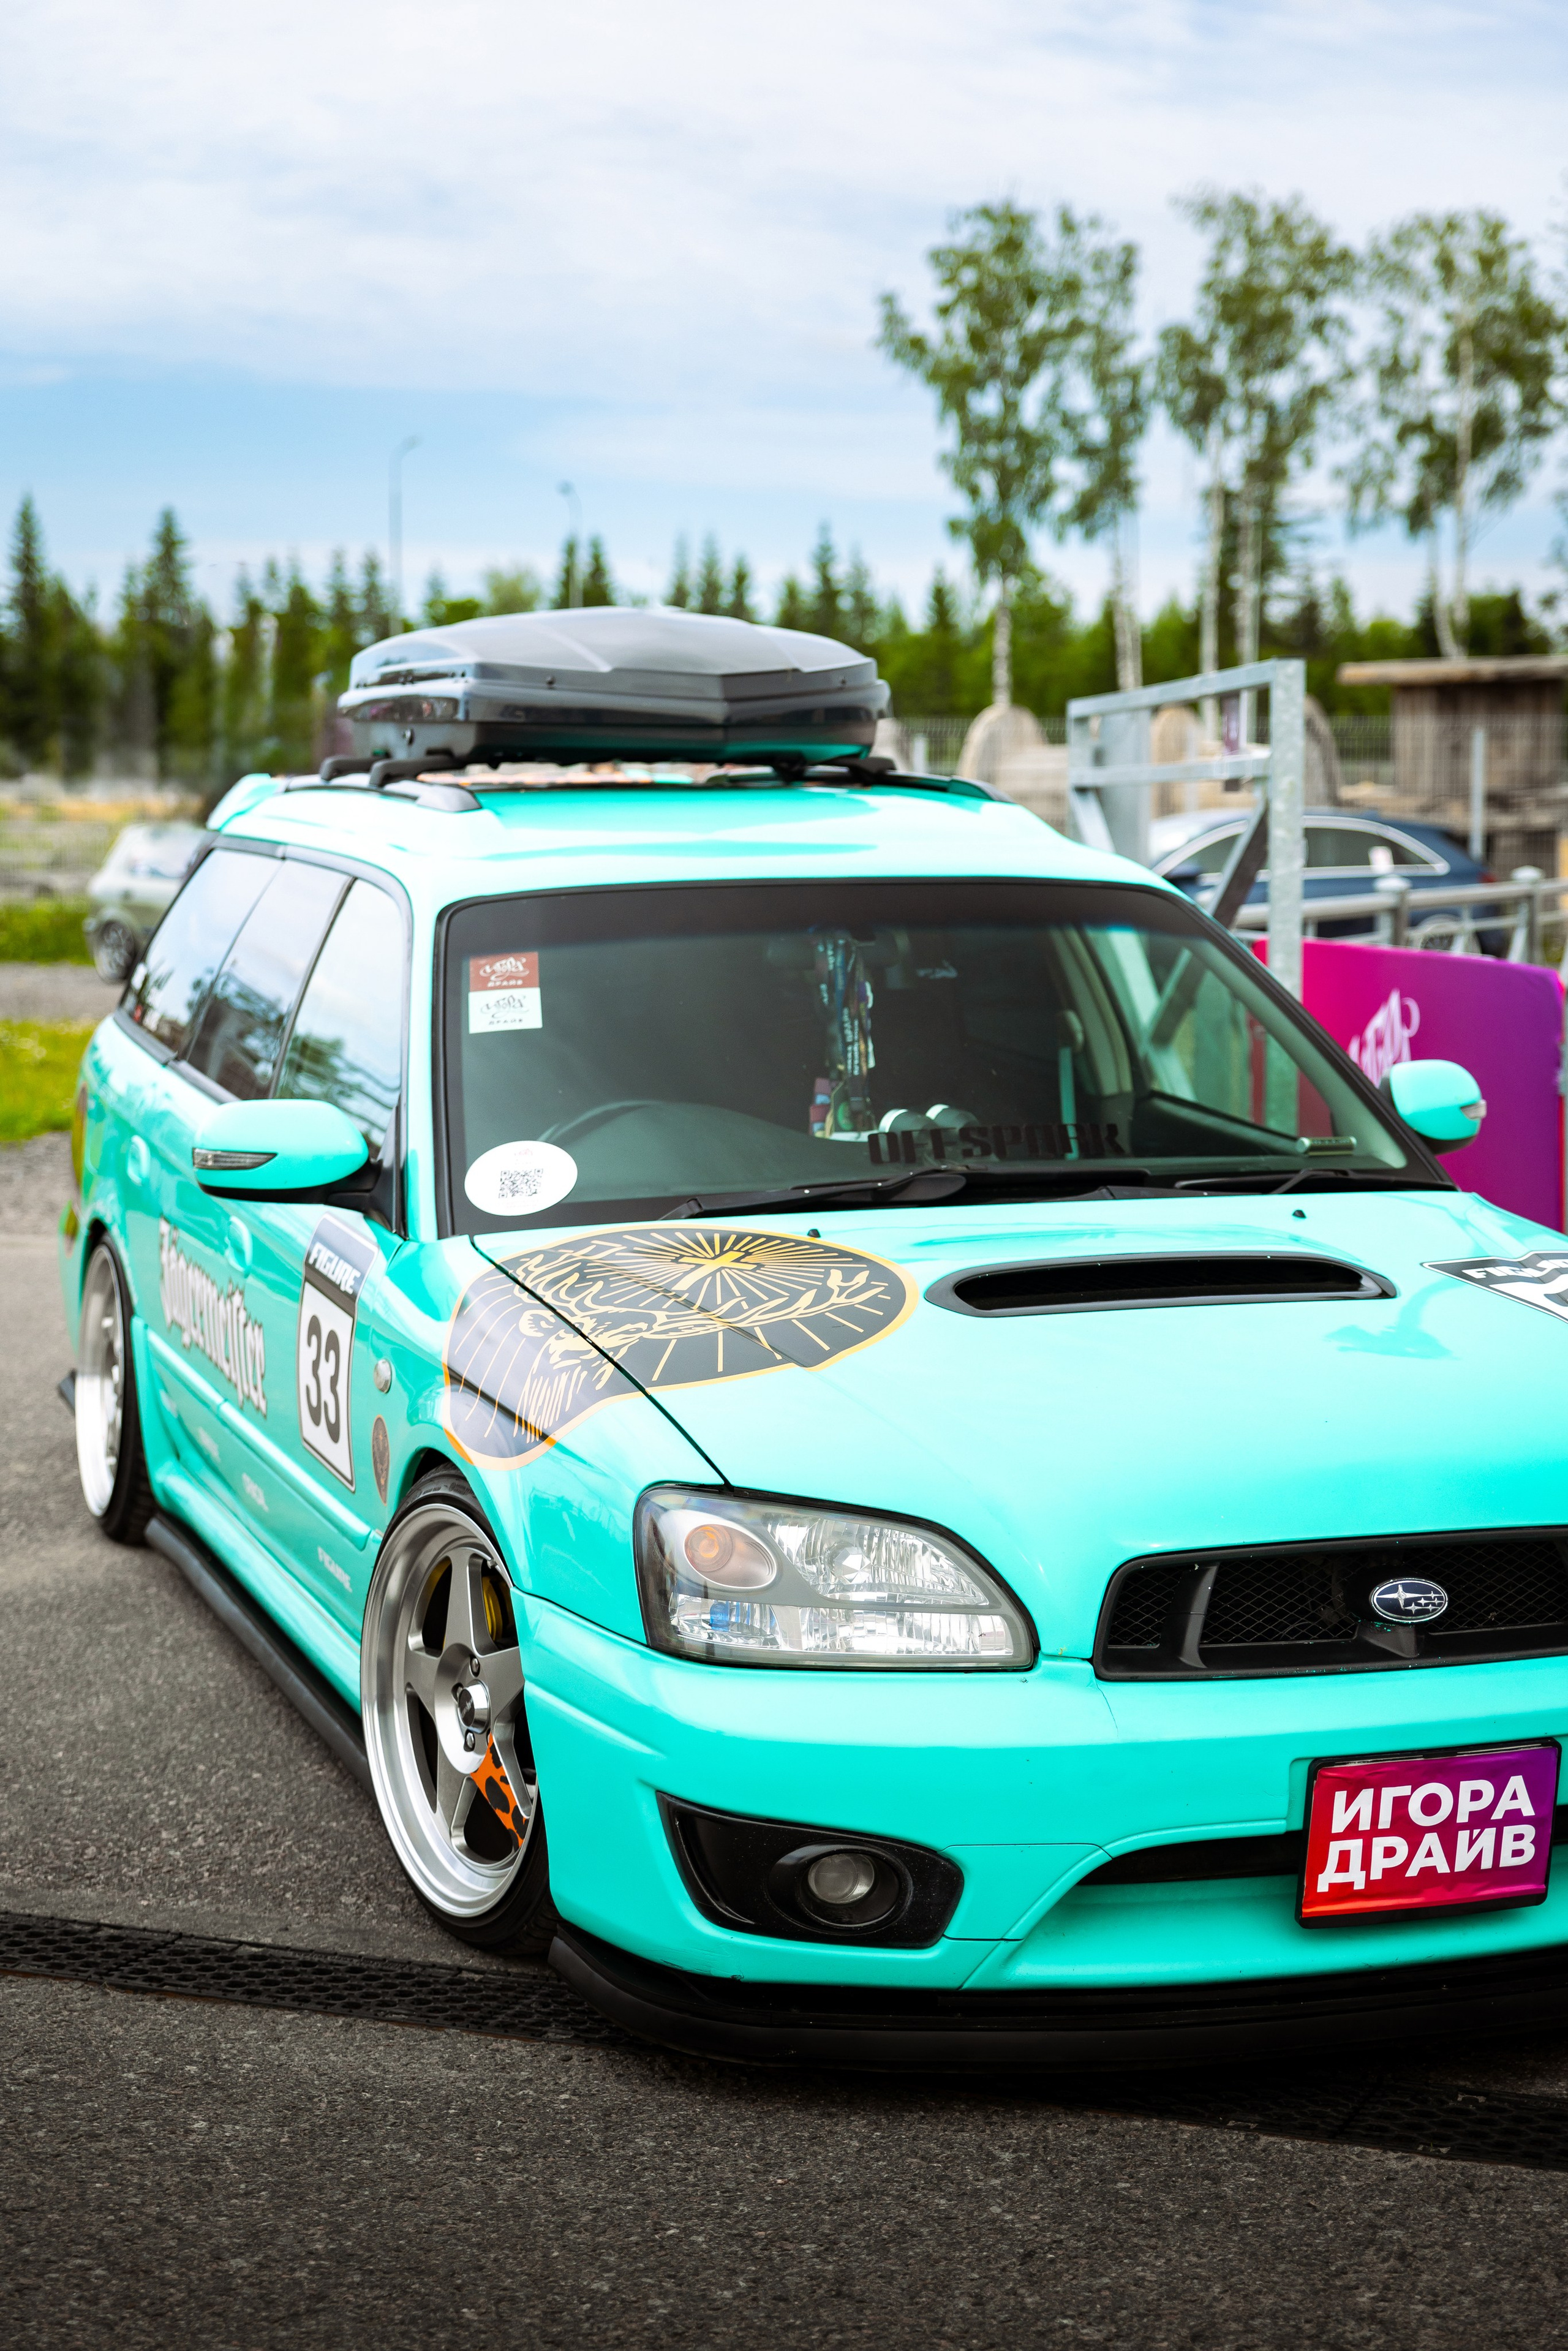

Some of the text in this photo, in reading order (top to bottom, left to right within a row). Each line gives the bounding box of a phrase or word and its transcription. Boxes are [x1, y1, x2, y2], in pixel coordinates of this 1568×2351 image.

[308, 1241, 362, 1295] FIGURE
[306, 1315, 340, 1444] 33
[1331, 1775, 1536, 1833] ИГОРА
[1316, 1824, 1536, 1893] ДРАЙВ
